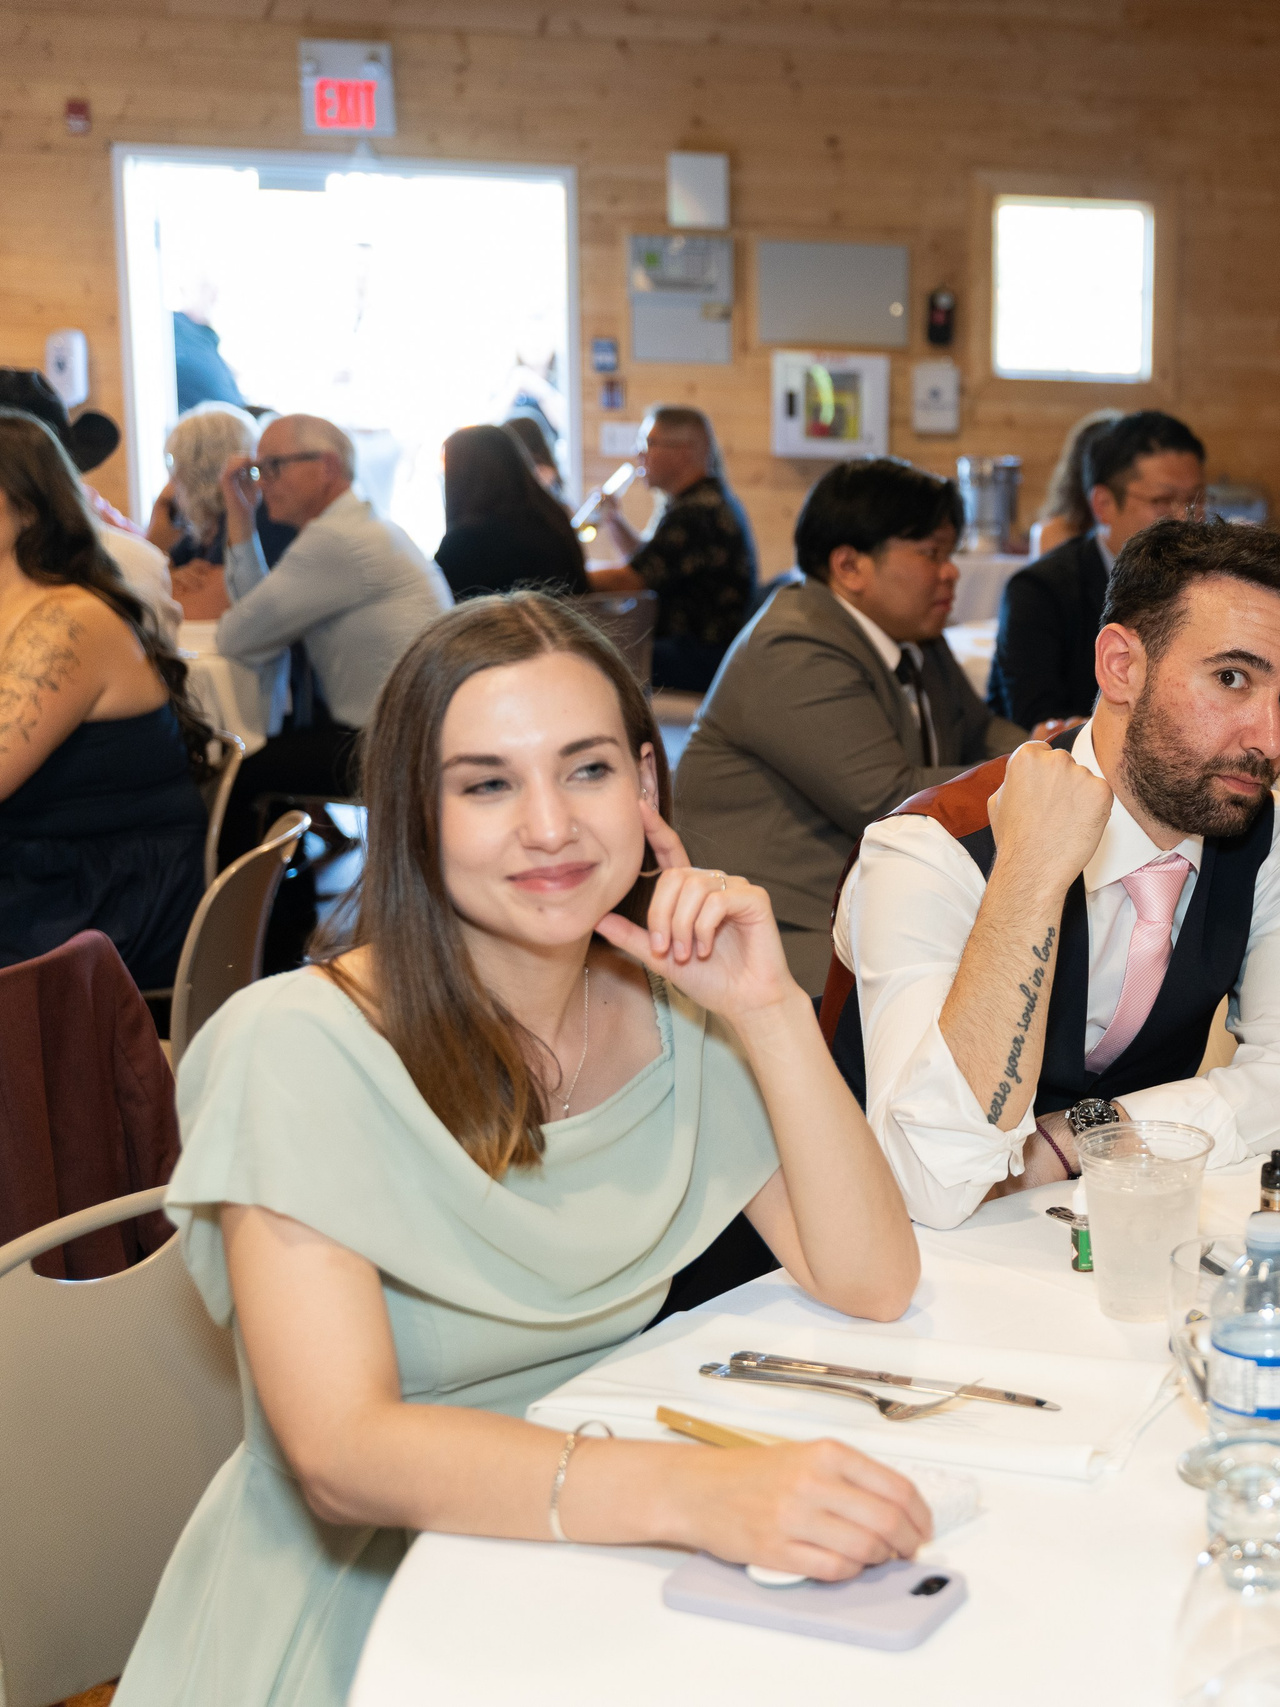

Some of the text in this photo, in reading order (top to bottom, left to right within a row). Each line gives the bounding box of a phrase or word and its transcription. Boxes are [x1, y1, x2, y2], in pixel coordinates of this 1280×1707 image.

[315, 77, 377, 130] EXIT
[1032, 926, 1056, 963] love
[1029, 966, 1045, 988] in
[1017, 983, 1038, 1032] soul
[1004, 1034, 1025, 1084] your
